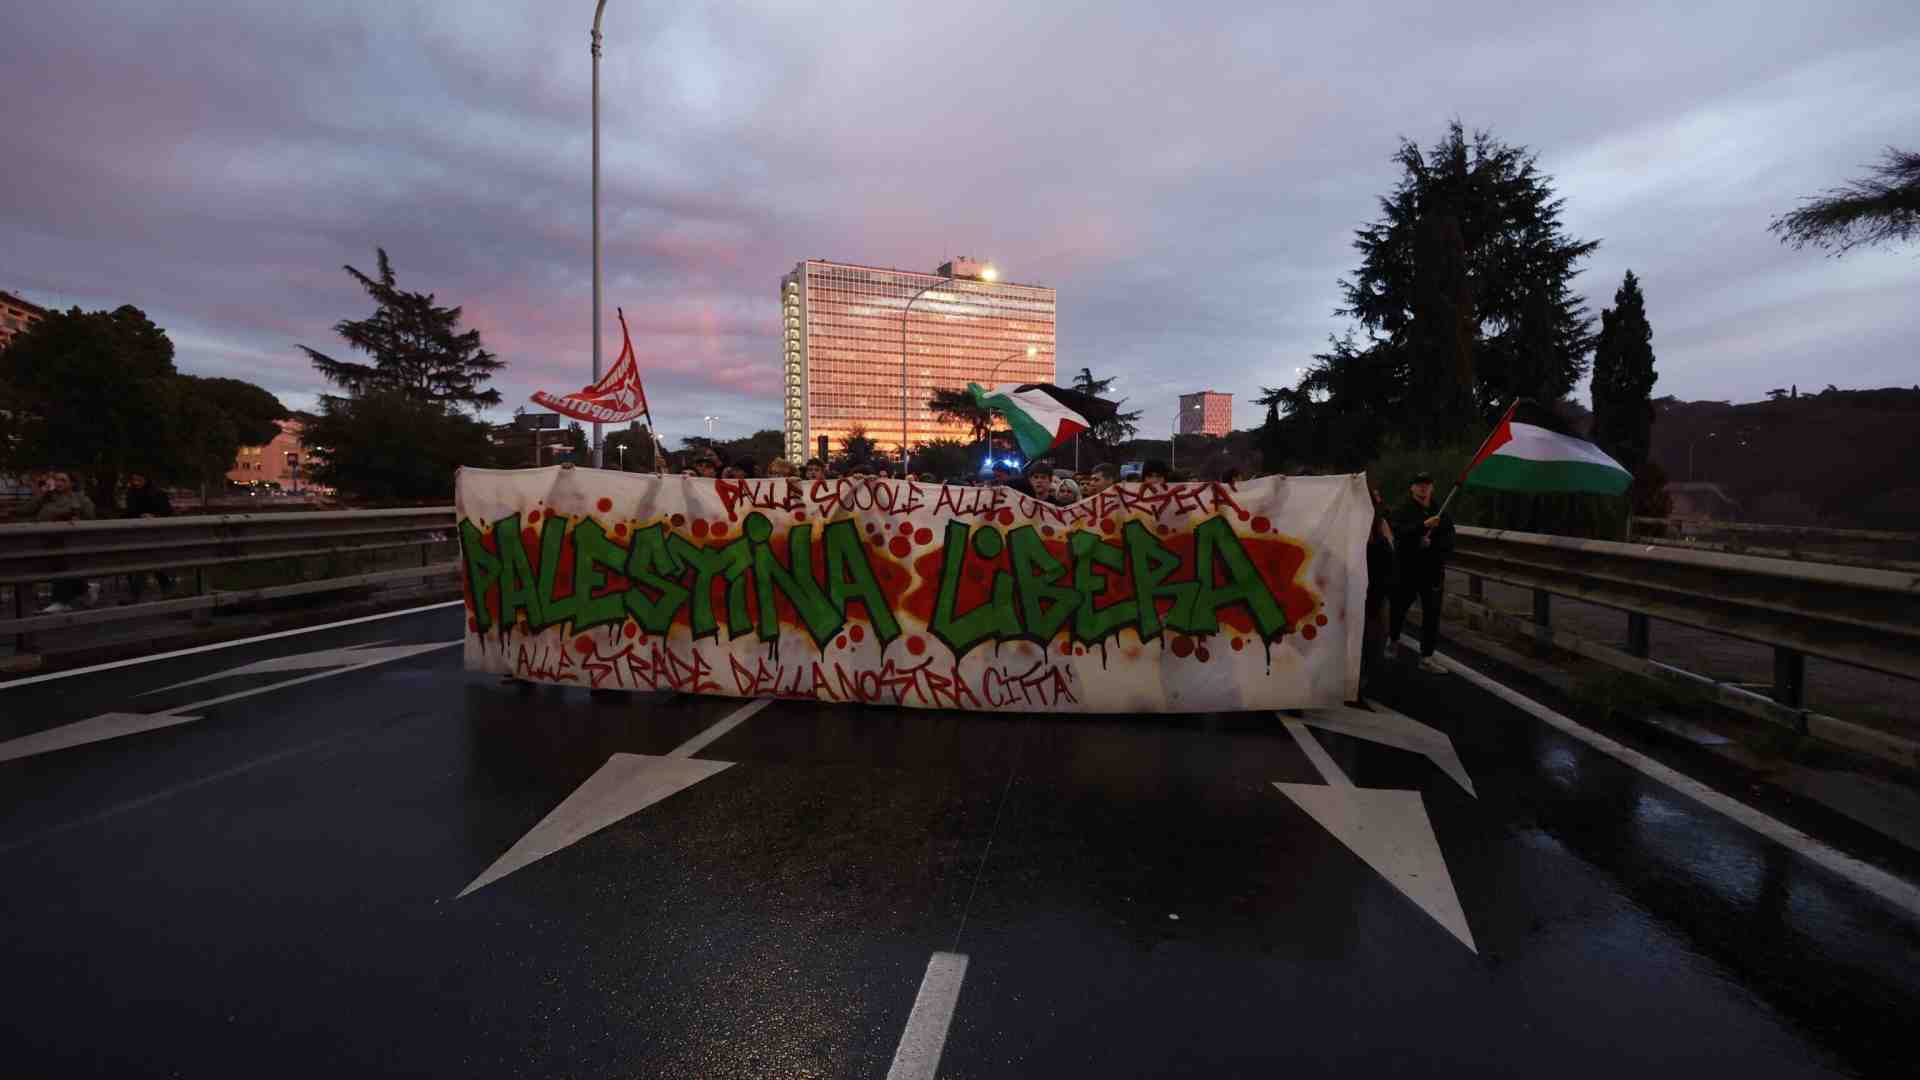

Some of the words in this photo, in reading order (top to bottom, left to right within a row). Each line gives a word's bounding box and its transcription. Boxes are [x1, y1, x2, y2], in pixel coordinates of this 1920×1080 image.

[932, 483, 1013, 517] ALLE
[516, 642, 579, 682] ALLE
[582, 641, 723, 693] STRADE
[728, 653, 839, 699] DELLA
[833, 656, 983, 707] NOSTRA
